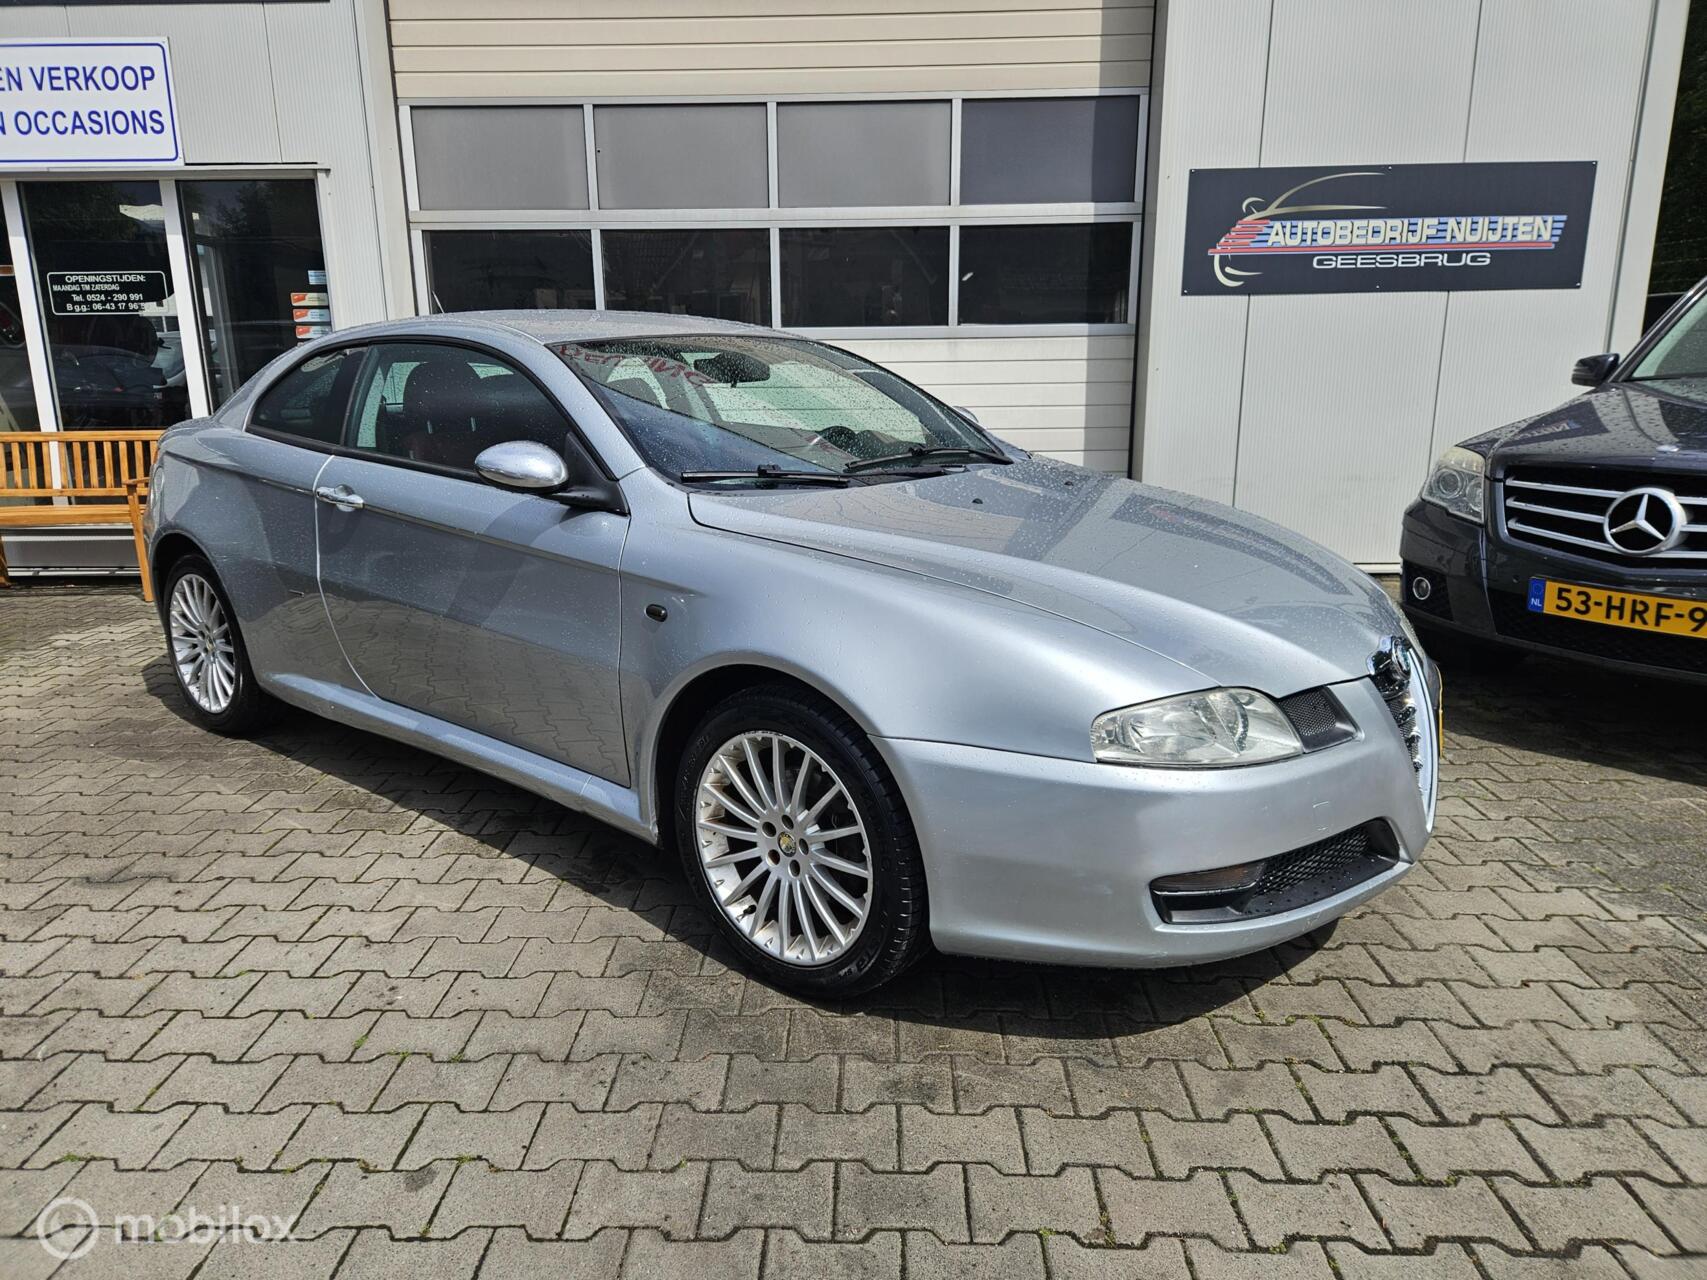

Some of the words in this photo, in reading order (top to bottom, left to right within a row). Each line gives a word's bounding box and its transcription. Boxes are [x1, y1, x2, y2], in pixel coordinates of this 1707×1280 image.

[29, 65, 156, 91] VERKOOP
[14, 109, 165, 135] OCCASIONS
[1267, 218, 1440, 247] AUTOBEDRIJF
[1445, 214, 1554, 243] NUIJTEN
[1312, 252, 1491, 269] GEESBRUG
[65, 274, 146, 283] OPENINGSTIJDEN:
[52, 284, 80, 292] MAANDAG
[91, 283, 120, 291] ZATERDAG
[71, 294, 85, 302] Tel.
[86, 294, 106, 302] 0524
[112, 293, 128, 301] 290
[129, 293, 143, 301] 991
[92, 303, 116, 311] 06-43
[128, 302, 139, 310] 96
[1531, 598, 1542, 607] NL
[1555, 587, 1707, 632] 53-HRF-9
